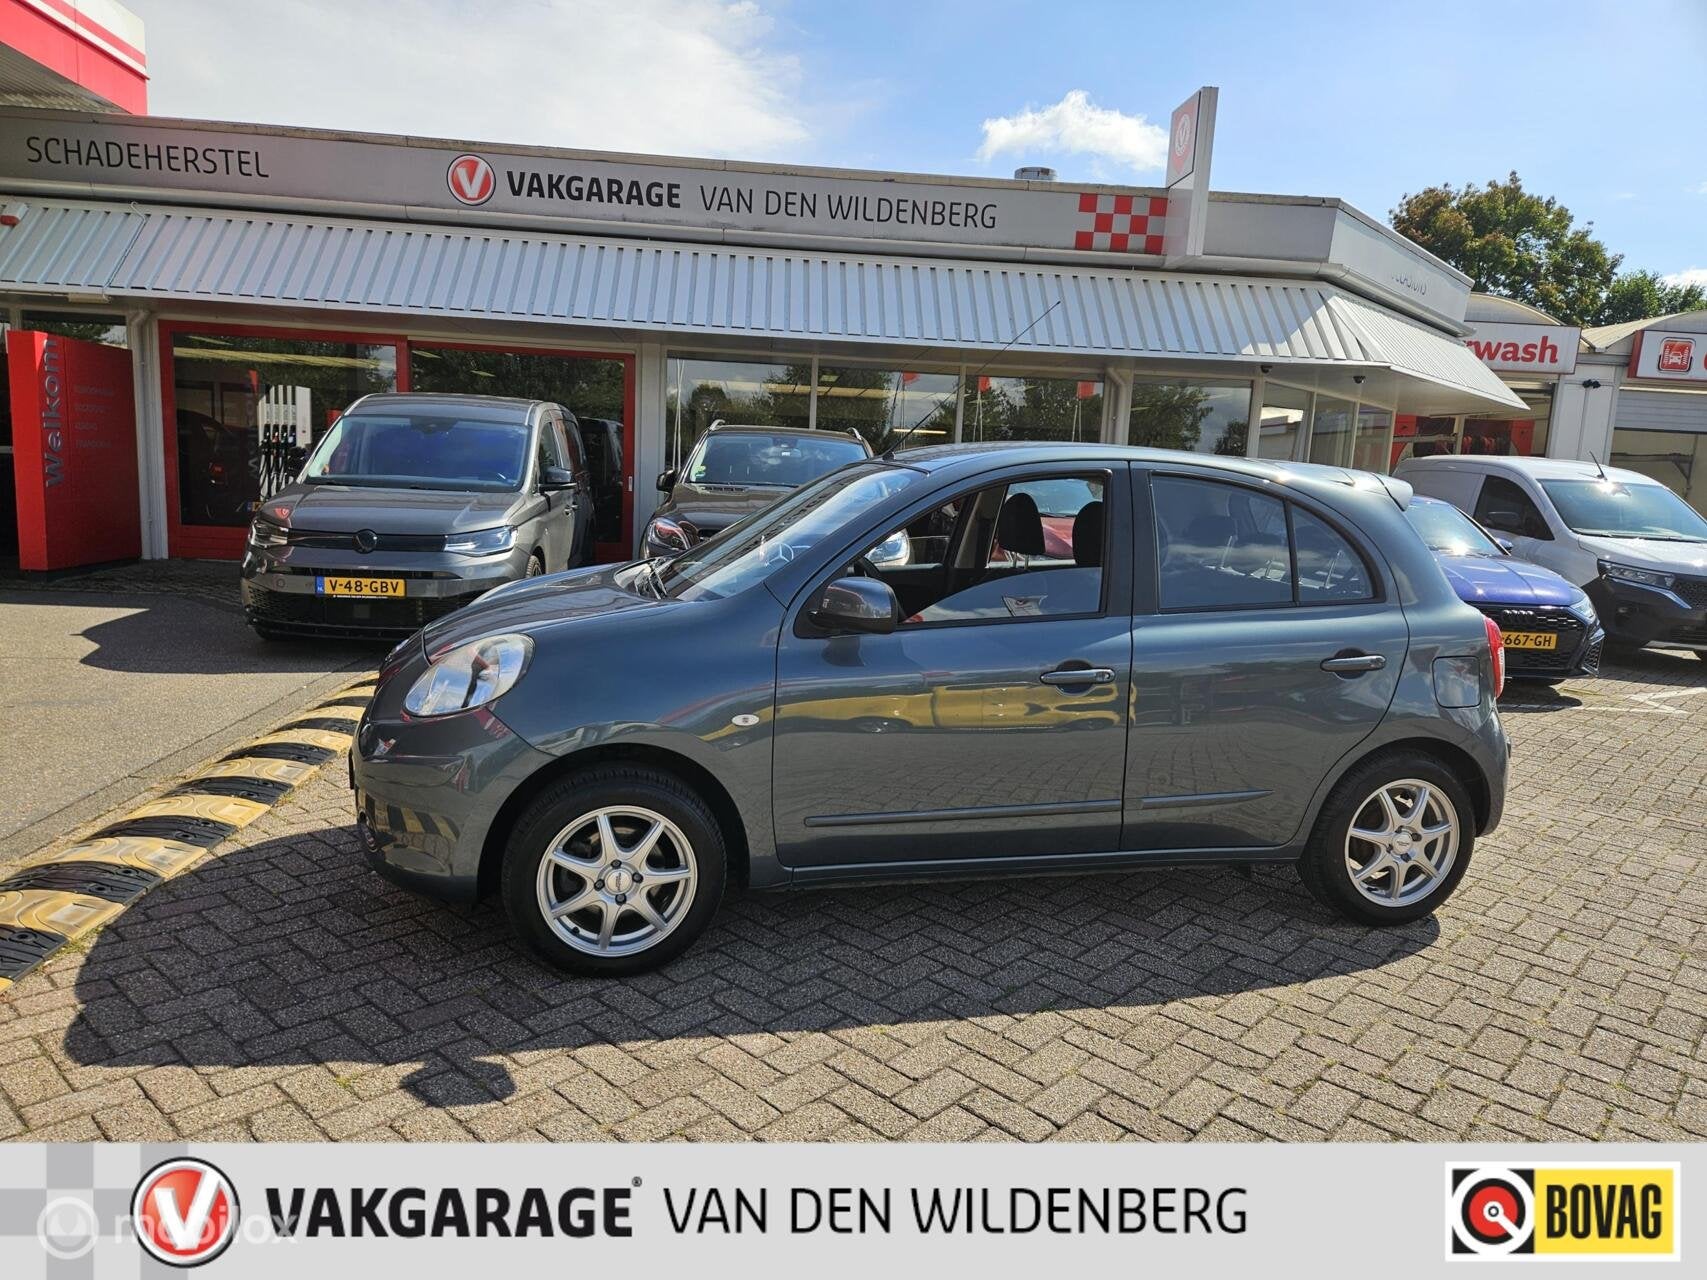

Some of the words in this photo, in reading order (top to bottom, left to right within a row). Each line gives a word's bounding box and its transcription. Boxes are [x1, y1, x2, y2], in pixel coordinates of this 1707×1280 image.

[26, 134, 270, 179] SCHADEHERSTEL
[507, 170, 681, 209] VAKGARAGE
[700, 184, 754, 214] VAN
[765, 190, 818, 219] DEN
[827, 194, 998, 230] WILDENBERG
[42, 338, 65, 488] Welkom
[329, 578, 399, 594] V-48-GBV
